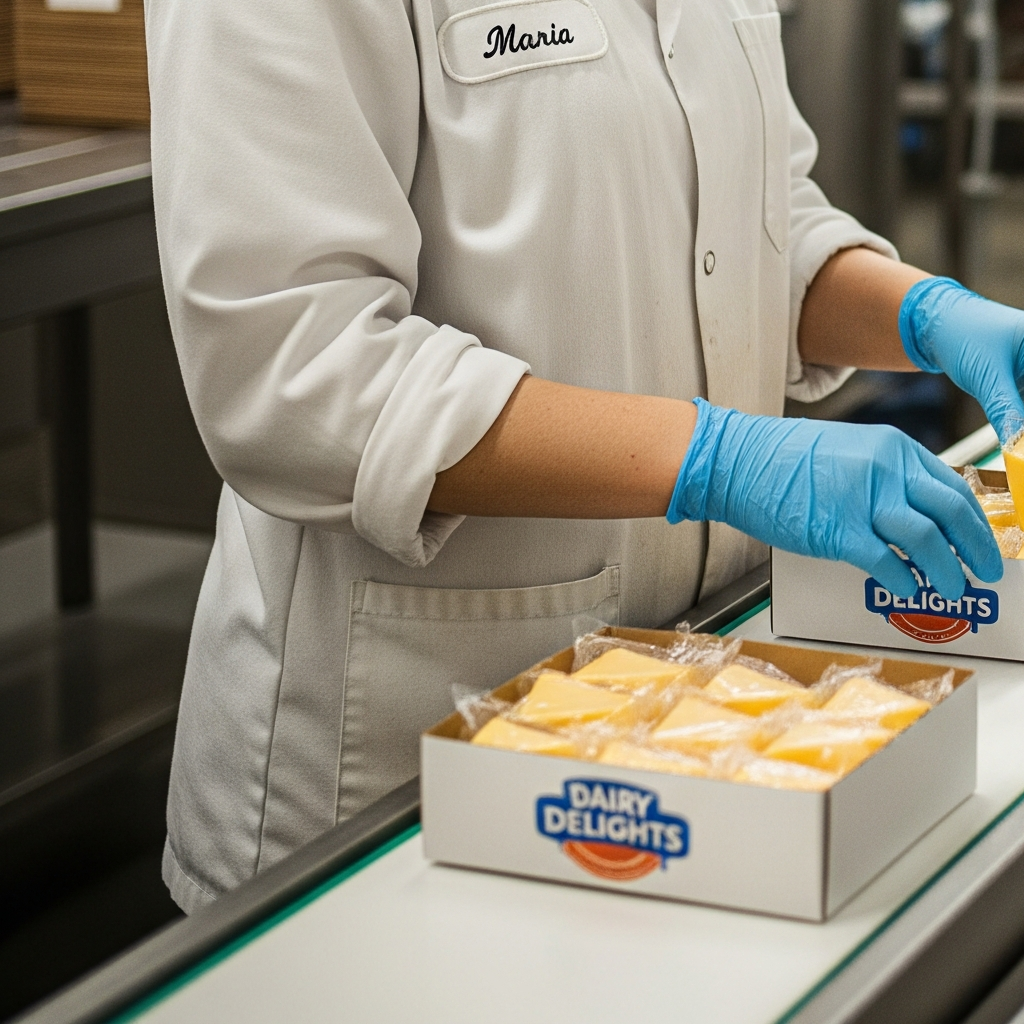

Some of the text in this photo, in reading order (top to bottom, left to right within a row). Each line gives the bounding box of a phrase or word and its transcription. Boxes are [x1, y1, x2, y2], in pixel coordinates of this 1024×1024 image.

[483, 23, 574, 58] Maria
[569, 781, 654, 819] DAIRY
[543, 805, 684, 853] DELIGHTS
